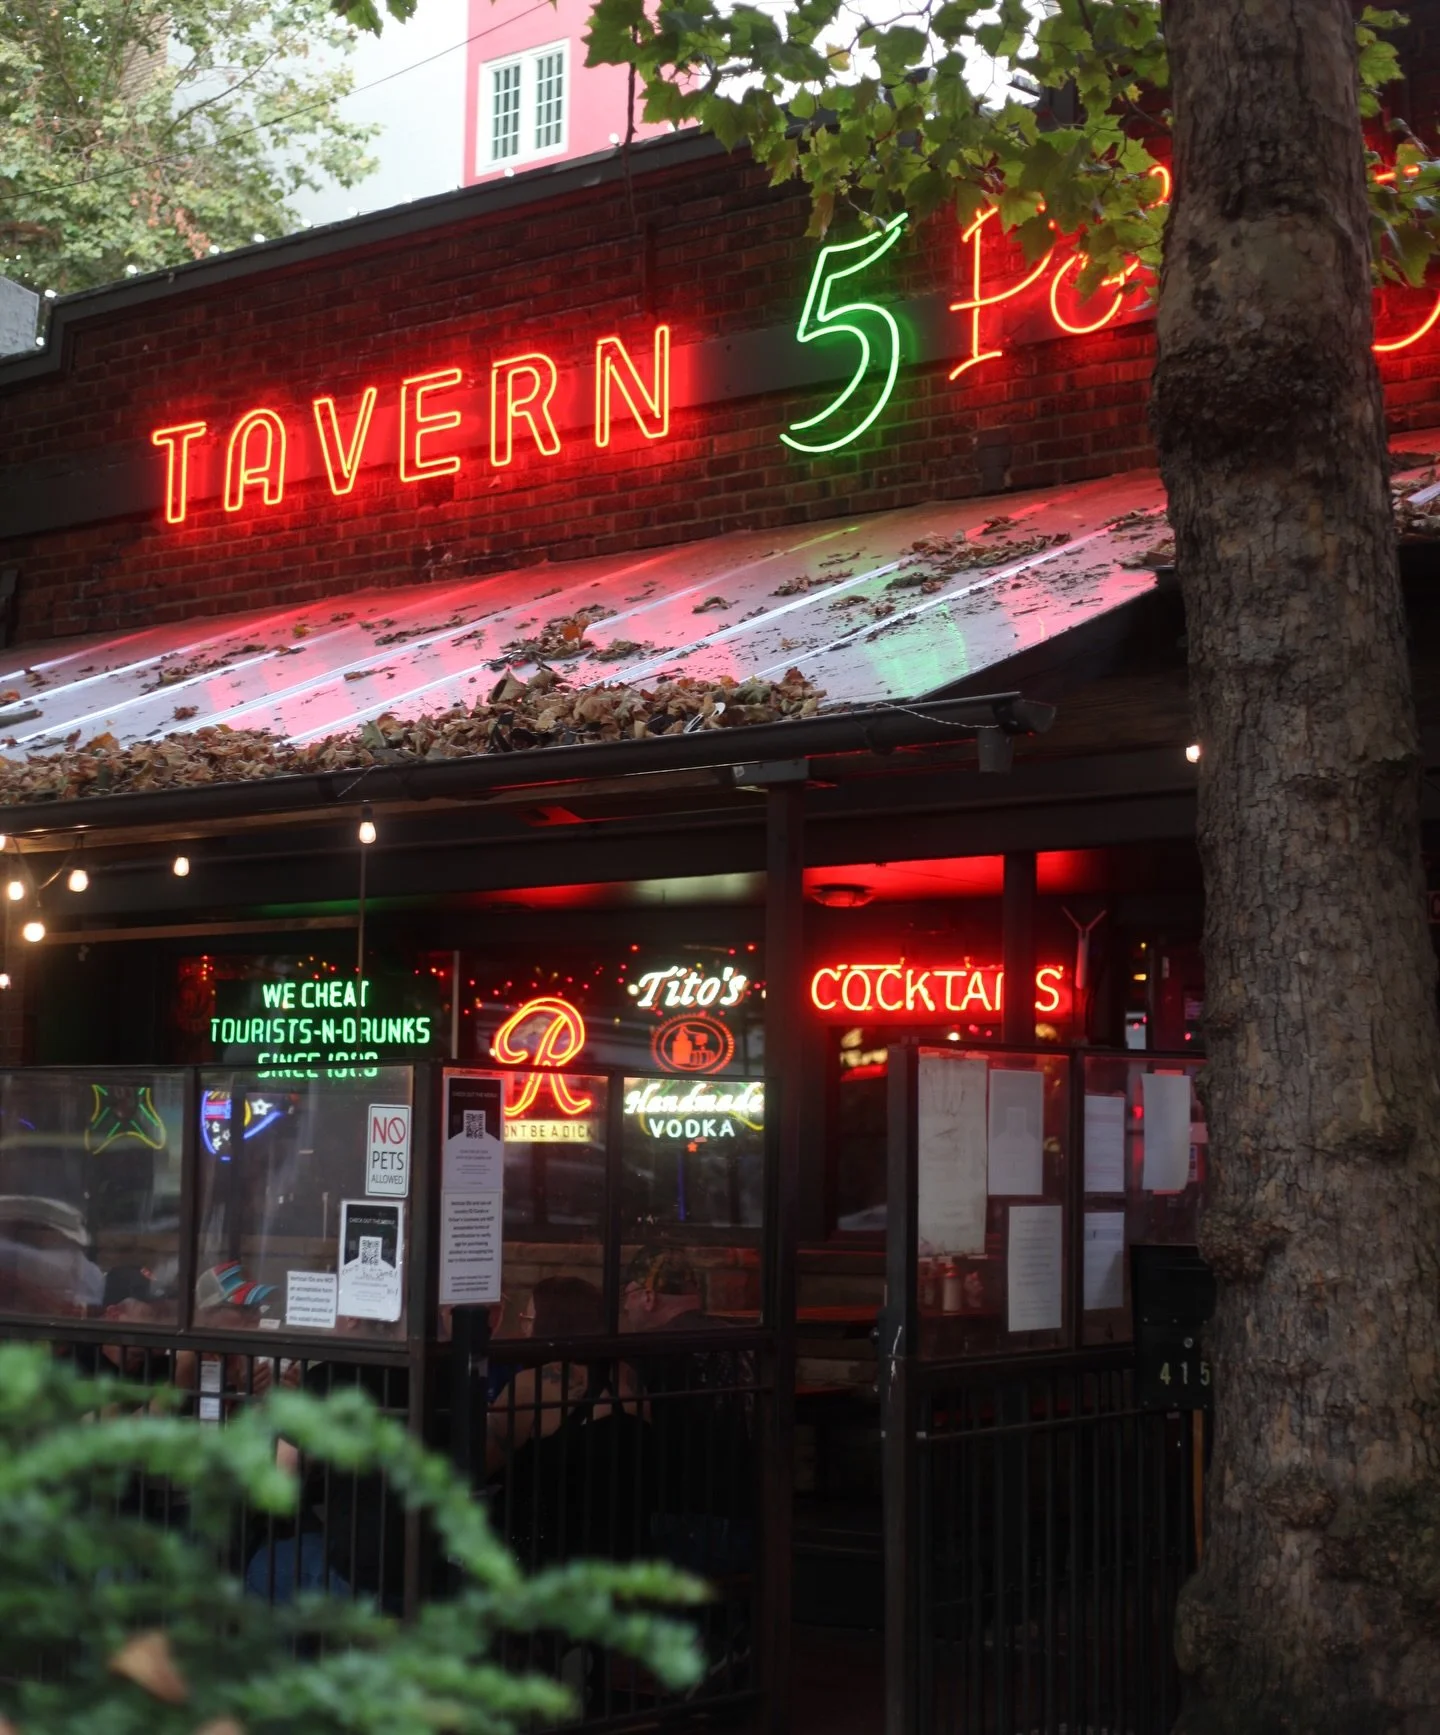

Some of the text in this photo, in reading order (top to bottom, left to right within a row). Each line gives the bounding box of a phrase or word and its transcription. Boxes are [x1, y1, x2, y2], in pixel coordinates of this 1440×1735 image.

[151, 324, 671, 524] TAVERN
[778, 211, 909, 454] 5
[262, 980, 369, 1009] WE CHEAT
[637, 964, 747, 1008] Tito's
[811, 967, 1063, 1012] COCKTAIS
[210, 1016, 431, 1044] TOURISTS-N-DRUNKS
[257, 1052, 320, 1078] SINCE
[624, 1081, 764, 1114] Handmade
[372, 1116, 406, 1144] NO
[551, 1125, 559, 1137] A
[649, 1118, 736, 1138] VODKA
[372, 1150, 404, 1171] PETS
[370, 1174, 404, 1185] ALLOWED
[1160, 1362, 1211, 1386] 415
